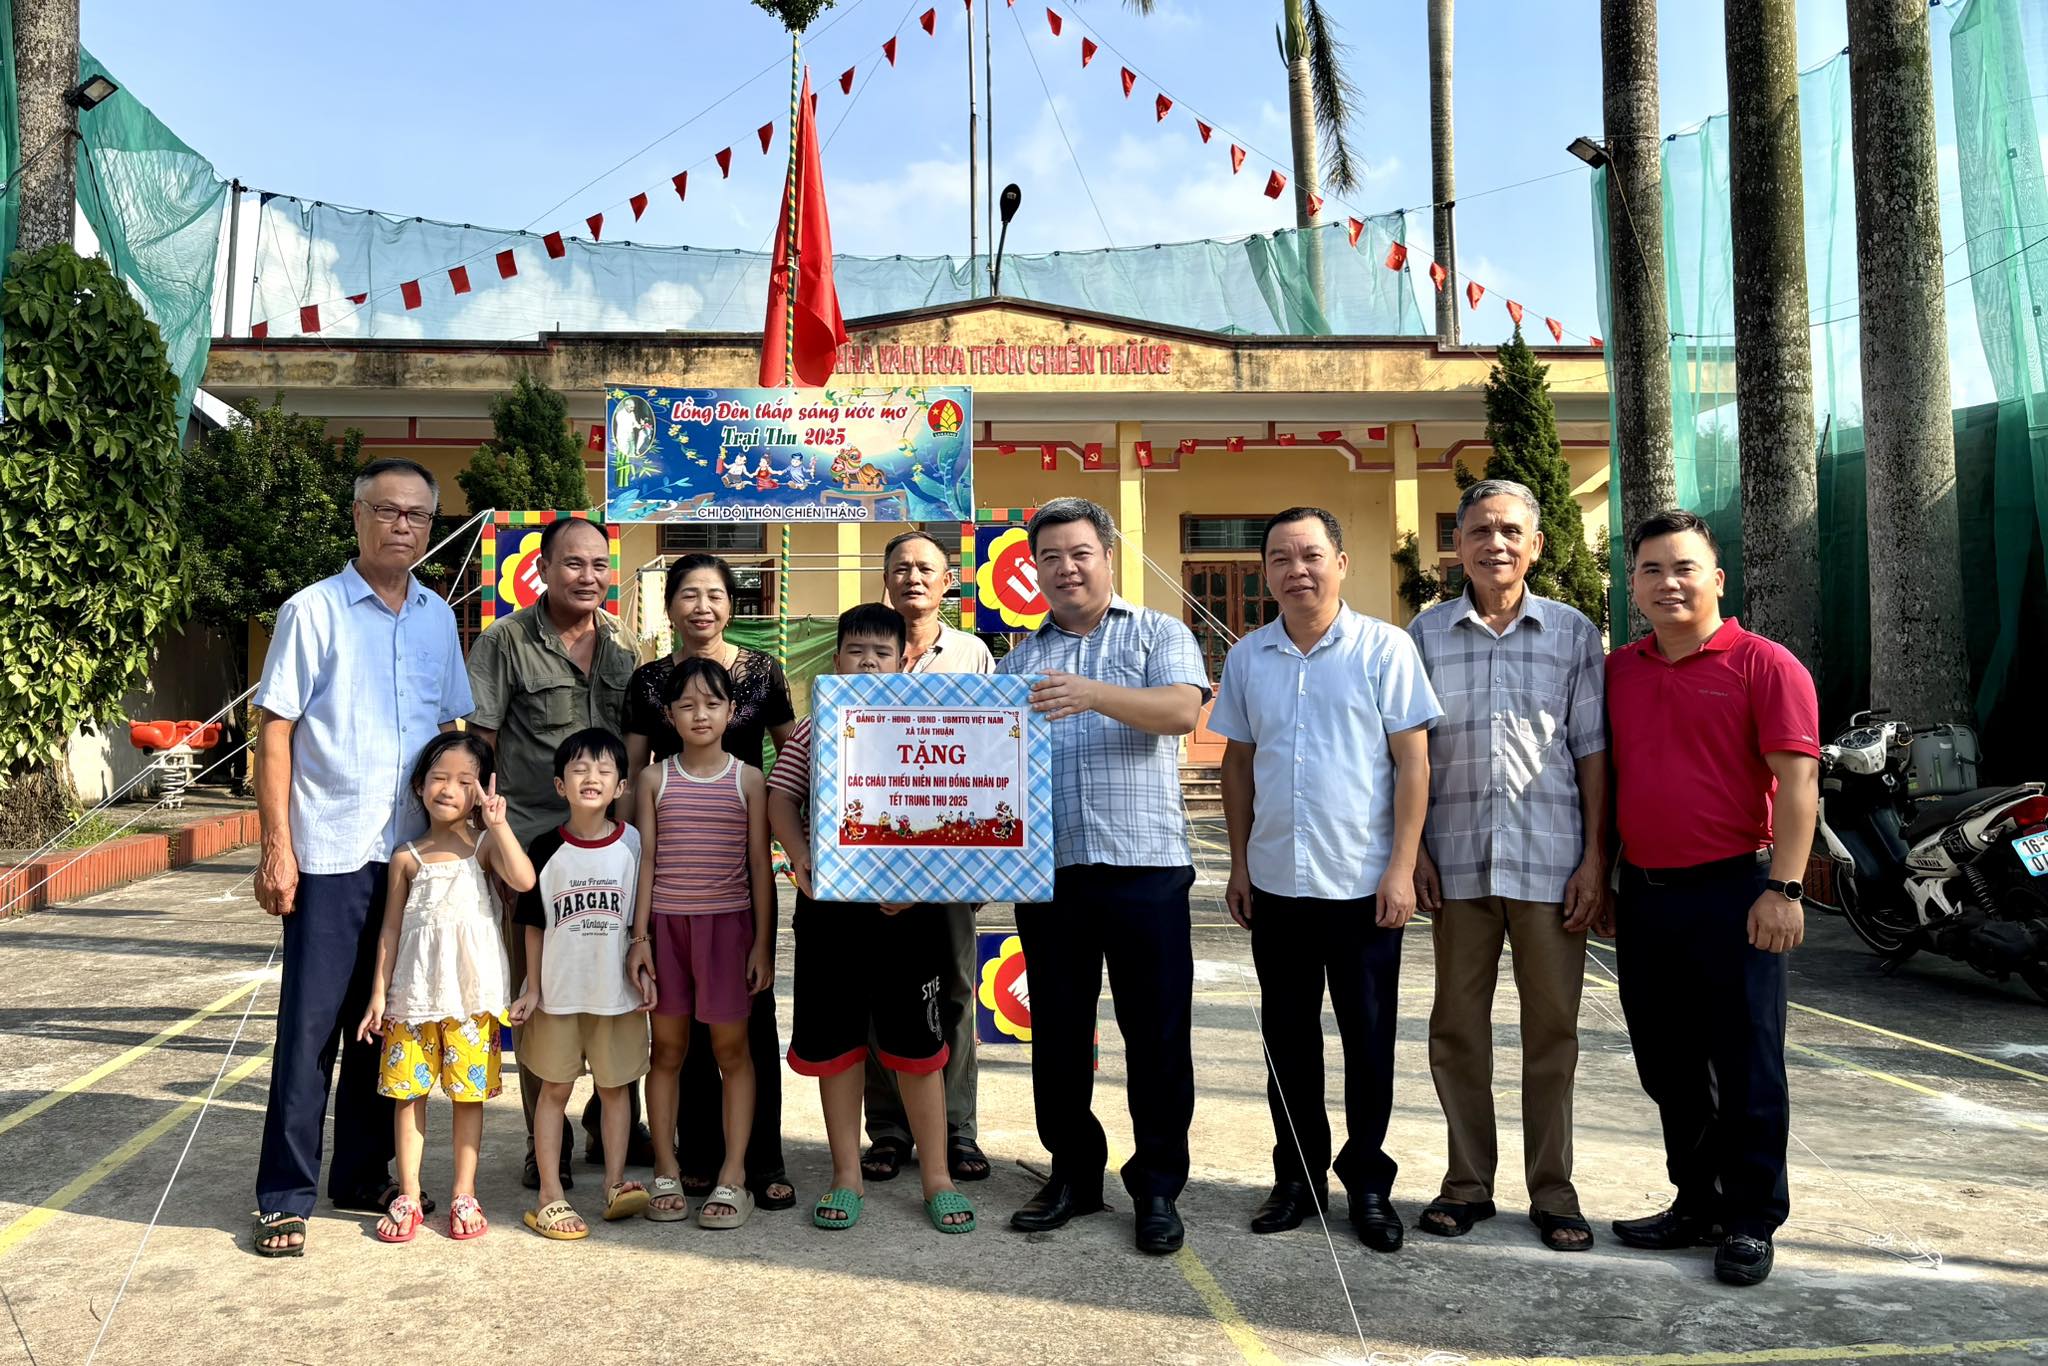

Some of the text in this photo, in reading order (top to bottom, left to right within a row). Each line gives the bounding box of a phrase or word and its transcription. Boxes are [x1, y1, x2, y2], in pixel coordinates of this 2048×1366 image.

[968, 337, 1026, 374] THÔN
[1028, 333, 1095, 374] CHIẾN
[1097, 337, 1172, 374] THẮNG
[673, 398, 909, 424] Lồng Đèn thắp sáng ước mơ
[723, 427, 847, 451] Trại Thu 2025
[698, 502, 868, 521] CHI ĐỘI THÔN CHIẾN THẮNG
[971, 715, 986, 725] VIỆT
[987, 716, 1004, 724] NAM
[916, 726, 931, 735] TÂN
[932, 726, 955, 737] THUẬN
[896, 739, 966, 770] TẶNG
[847, 773, 864, 787] CÁC
[865, 773, 887, 787] CHÁU
[888, 772, 911, 787] THIẾU
[912, 773, 931, 787] NIÊN
[933, 776, 947, 787] NHI
[972, 774, 994, 788] NHÂN
[996, 776, 1010, 791] DỊP
[889, 791, 968, 807] TẾT TRUNG THU 2025
[580, 919, 609, 931] Vintage
[260, 1212, 281, 1224] VIP
